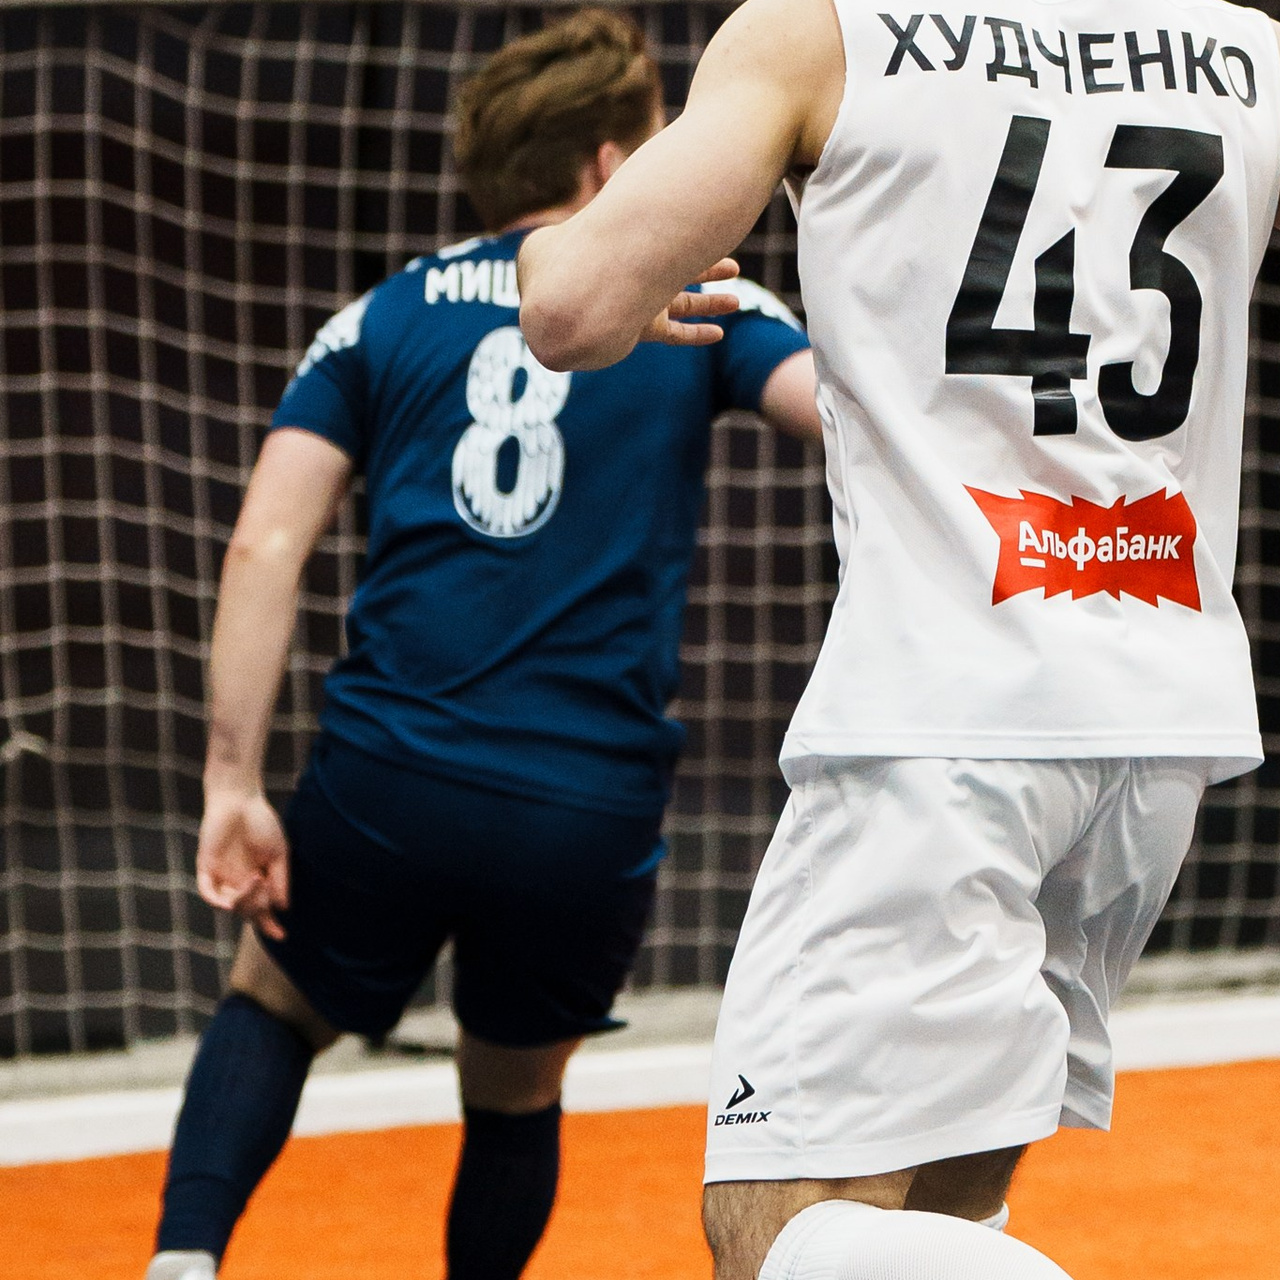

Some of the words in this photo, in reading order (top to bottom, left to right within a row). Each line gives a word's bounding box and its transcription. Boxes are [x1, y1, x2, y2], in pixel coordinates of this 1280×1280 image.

[877, 13, 1257, 108] ХУДЧЕНКО
[944, 115, 1224, 441] 43
[452, 326, 572, 538] 8
[714, 1111, 772, 1126] DEMIX
